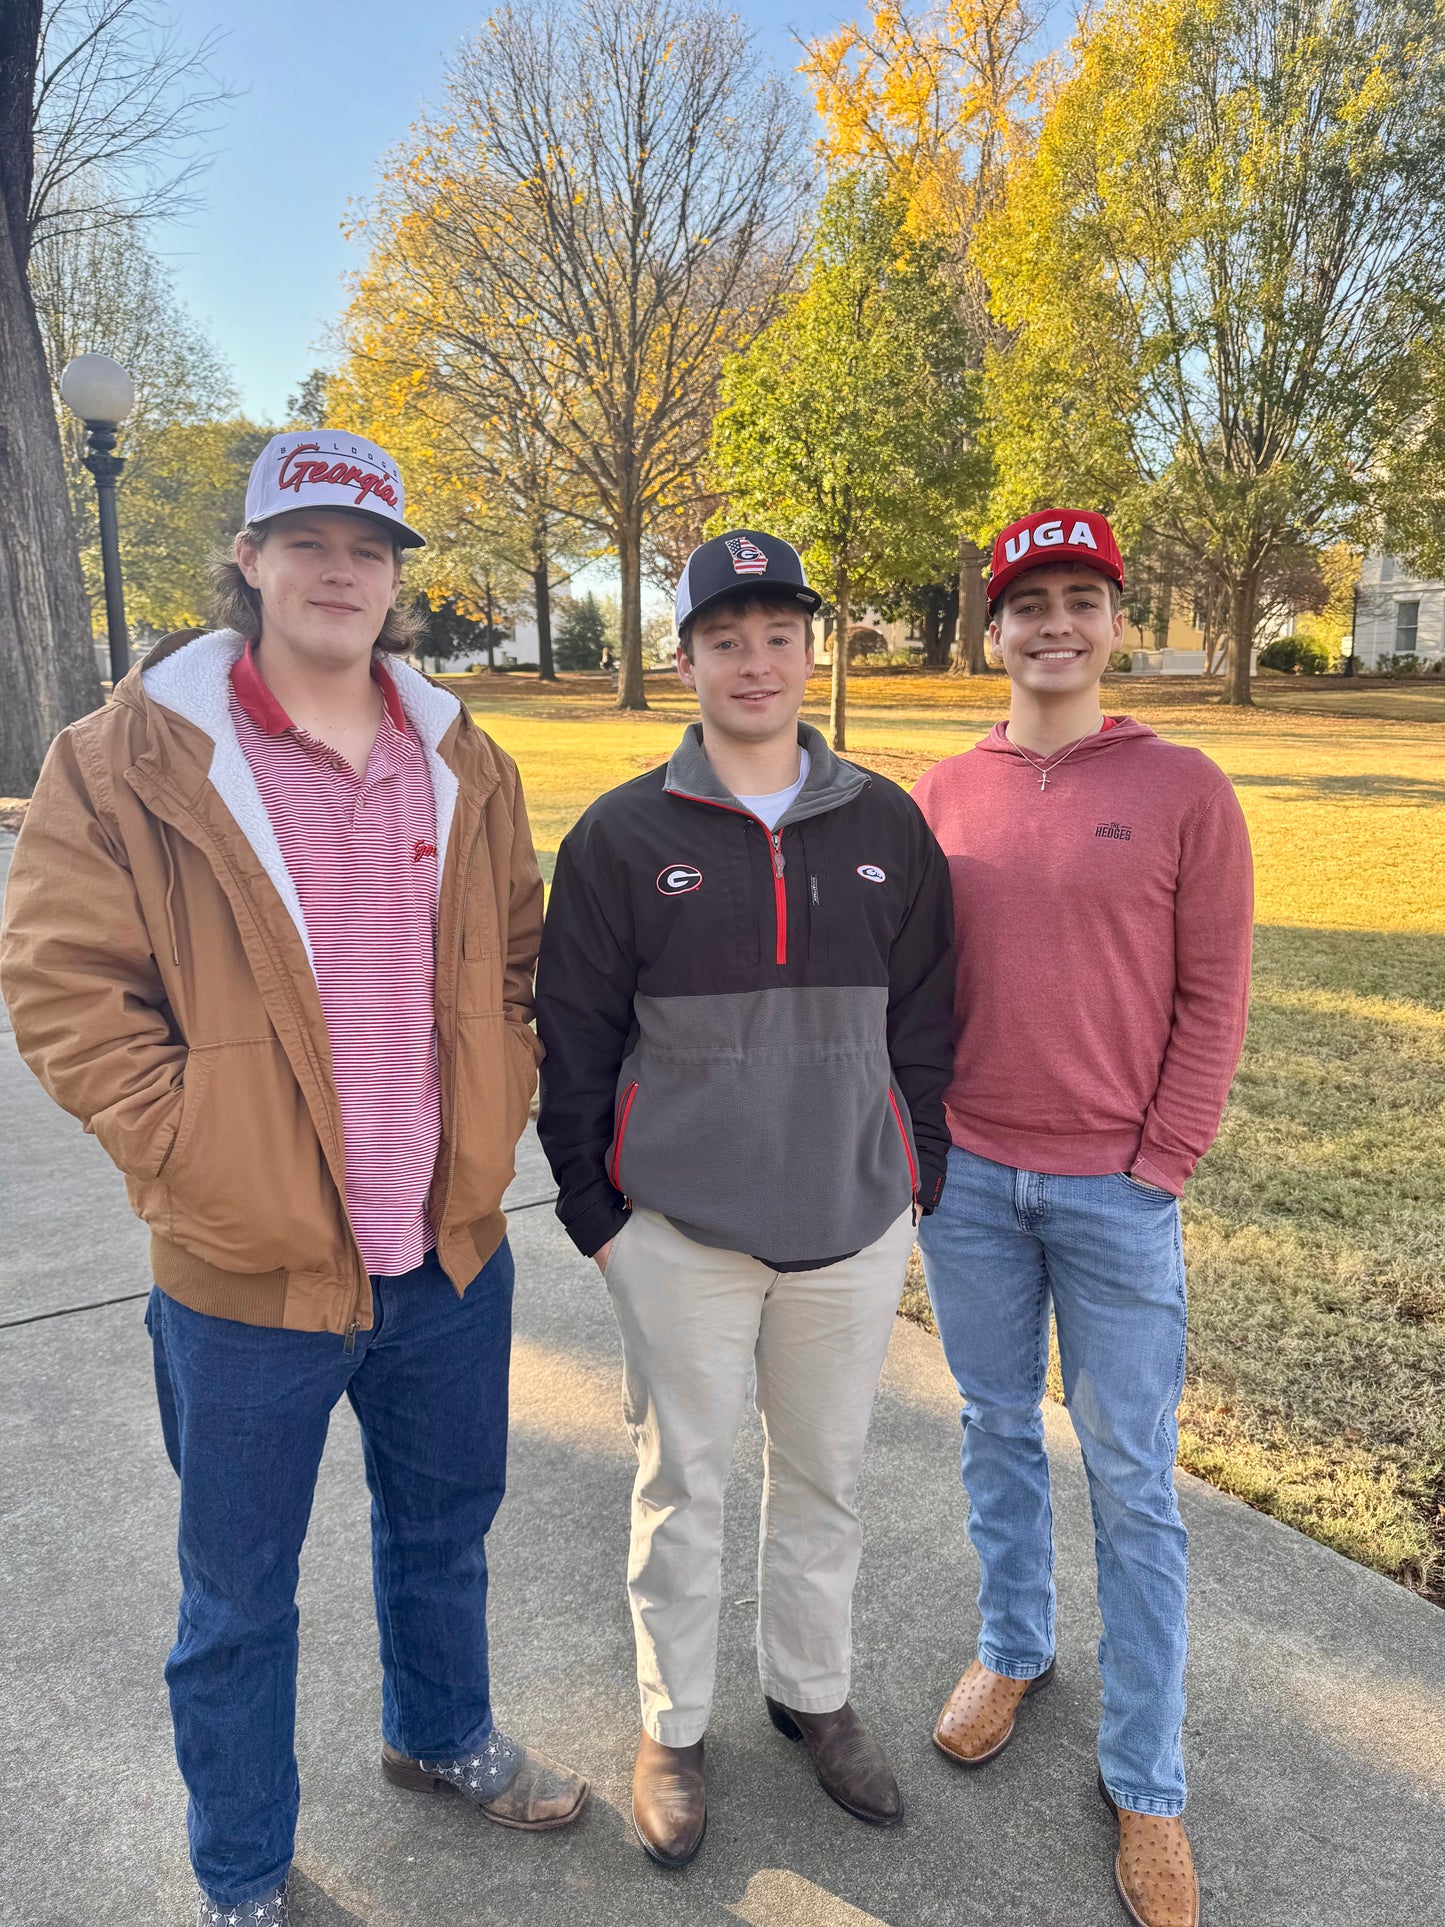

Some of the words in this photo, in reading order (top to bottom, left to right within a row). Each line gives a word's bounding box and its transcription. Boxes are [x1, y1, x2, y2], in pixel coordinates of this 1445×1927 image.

[279, 444, 398, 505] Georgia
[281, 443, 398, 477] BLDOGS
[1004, 520, 1098, 563] UGA
[1095, 826, 1131, 841] HEDGES
